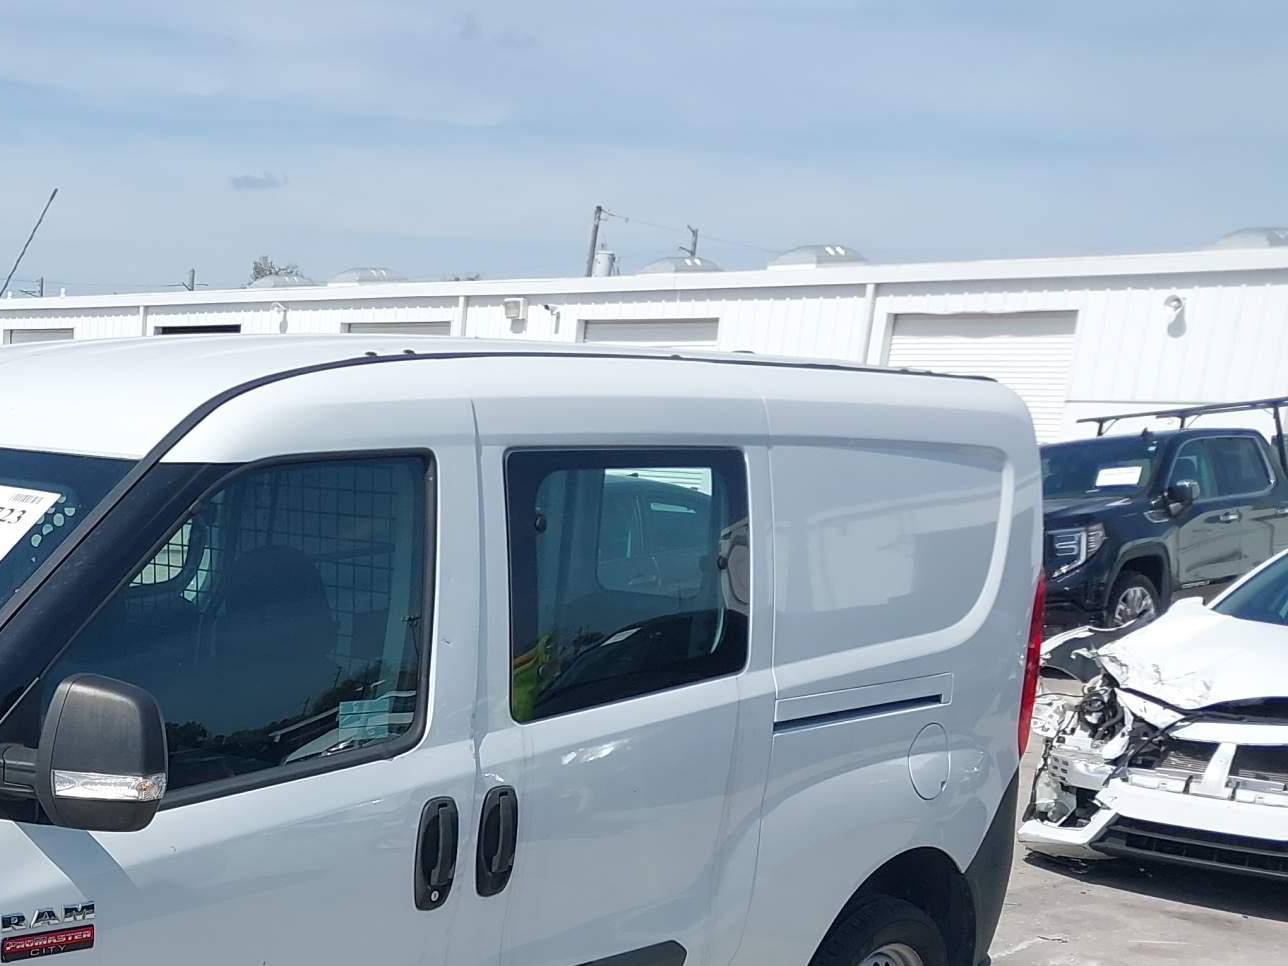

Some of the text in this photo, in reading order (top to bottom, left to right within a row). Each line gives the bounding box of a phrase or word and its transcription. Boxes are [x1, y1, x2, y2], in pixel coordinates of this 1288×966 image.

[0, 902, 95, 933] RAM
[5, 930, 92, 951] PROMASTER
[30, 944, 66, 957] CITY
